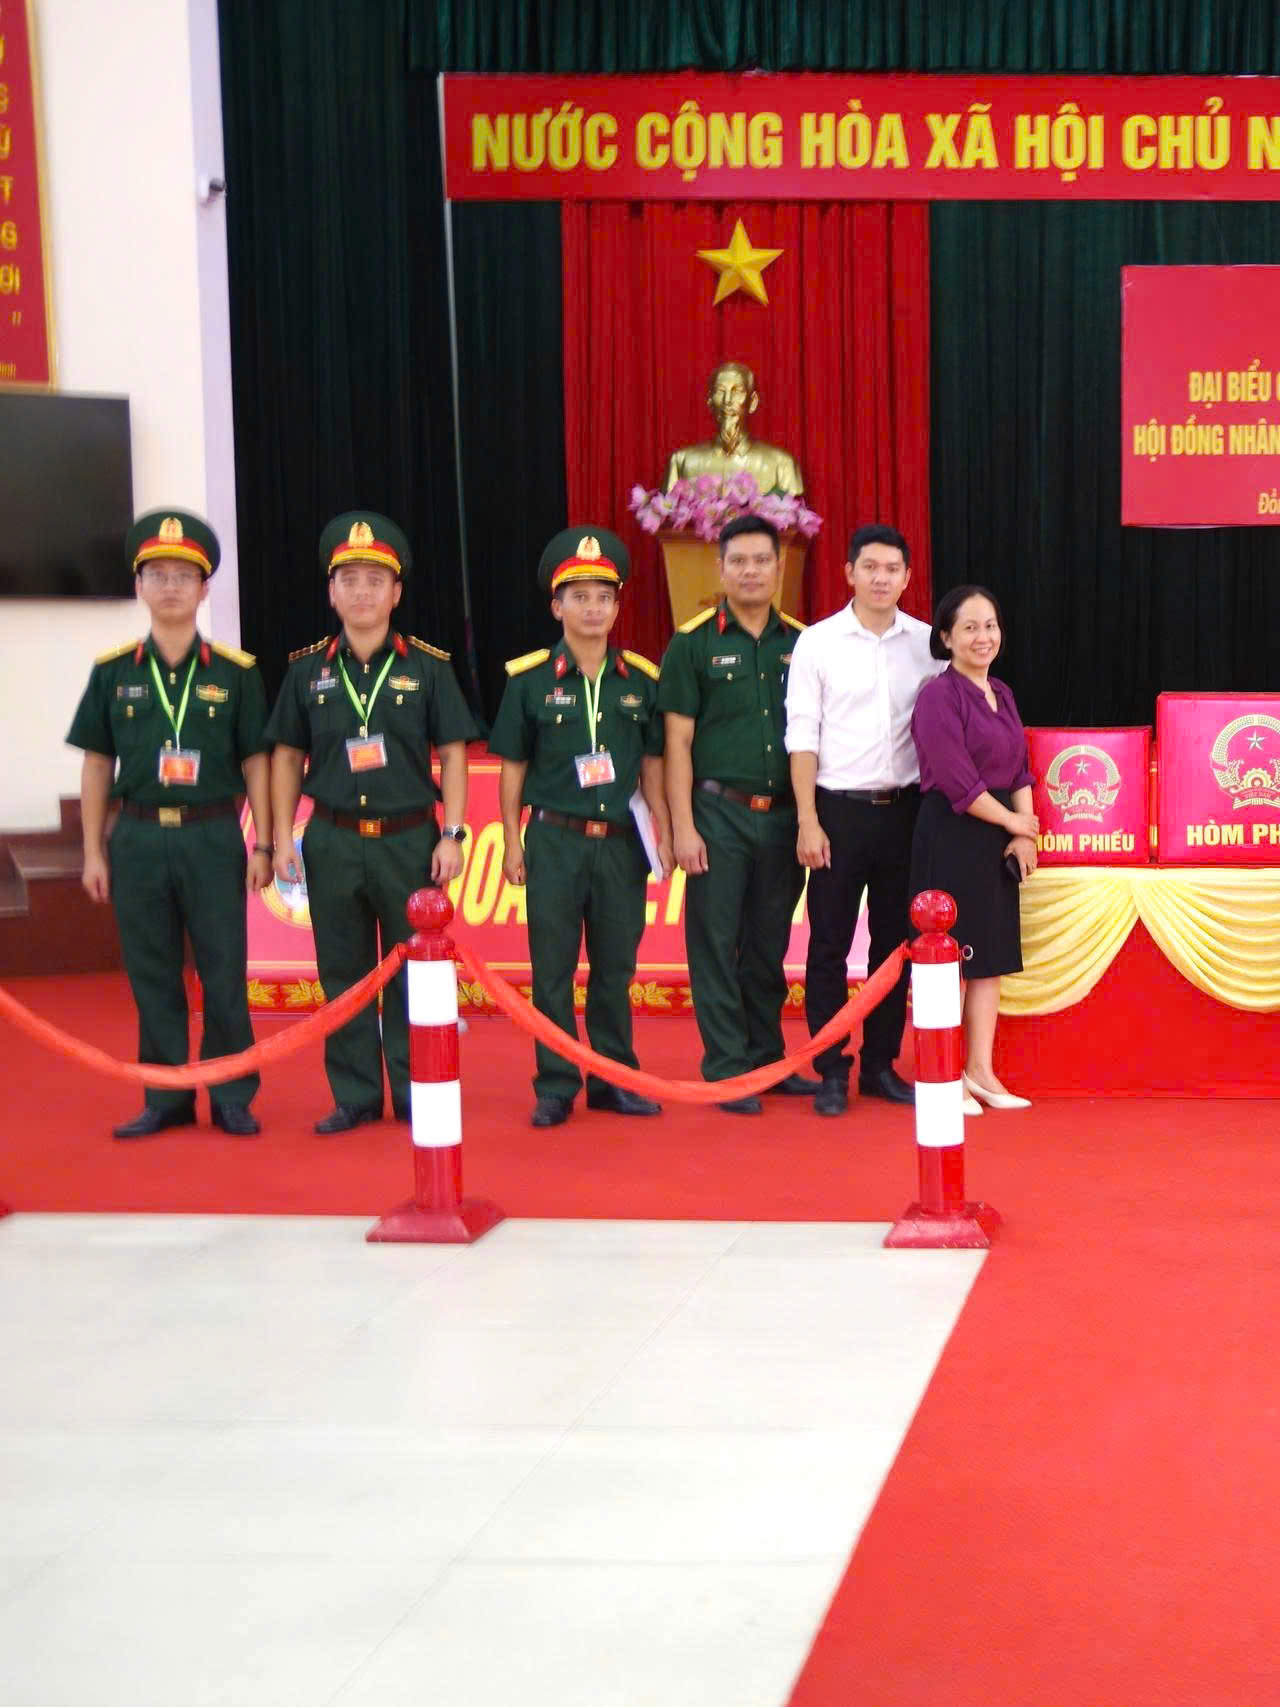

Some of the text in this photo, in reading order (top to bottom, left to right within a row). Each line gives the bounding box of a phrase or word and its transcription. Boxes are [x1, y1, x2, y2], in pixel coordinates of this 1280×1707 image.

[471, 101, 618, 171] NƯỚC
[635, 100, 784, 182] CỘNG
[800, 99, 910, 170] HÒA
[924, 103, 1000, 169] XÃ
[1014, 103, 1105, 182] HỘI
[1121, 96, 1231, 171] CHỦ
[1189, 371, 1222, 409] ĐẠI
[1226, 359, 1272, 402] BIỂU
[1133, 418, 1166, 462] HỘI
[1170, 414, 1224, 456] ĐỒNG
[1079, 829, 1135, 852] PHIẾU
[1186, 819, 1244, 846] HÒM
